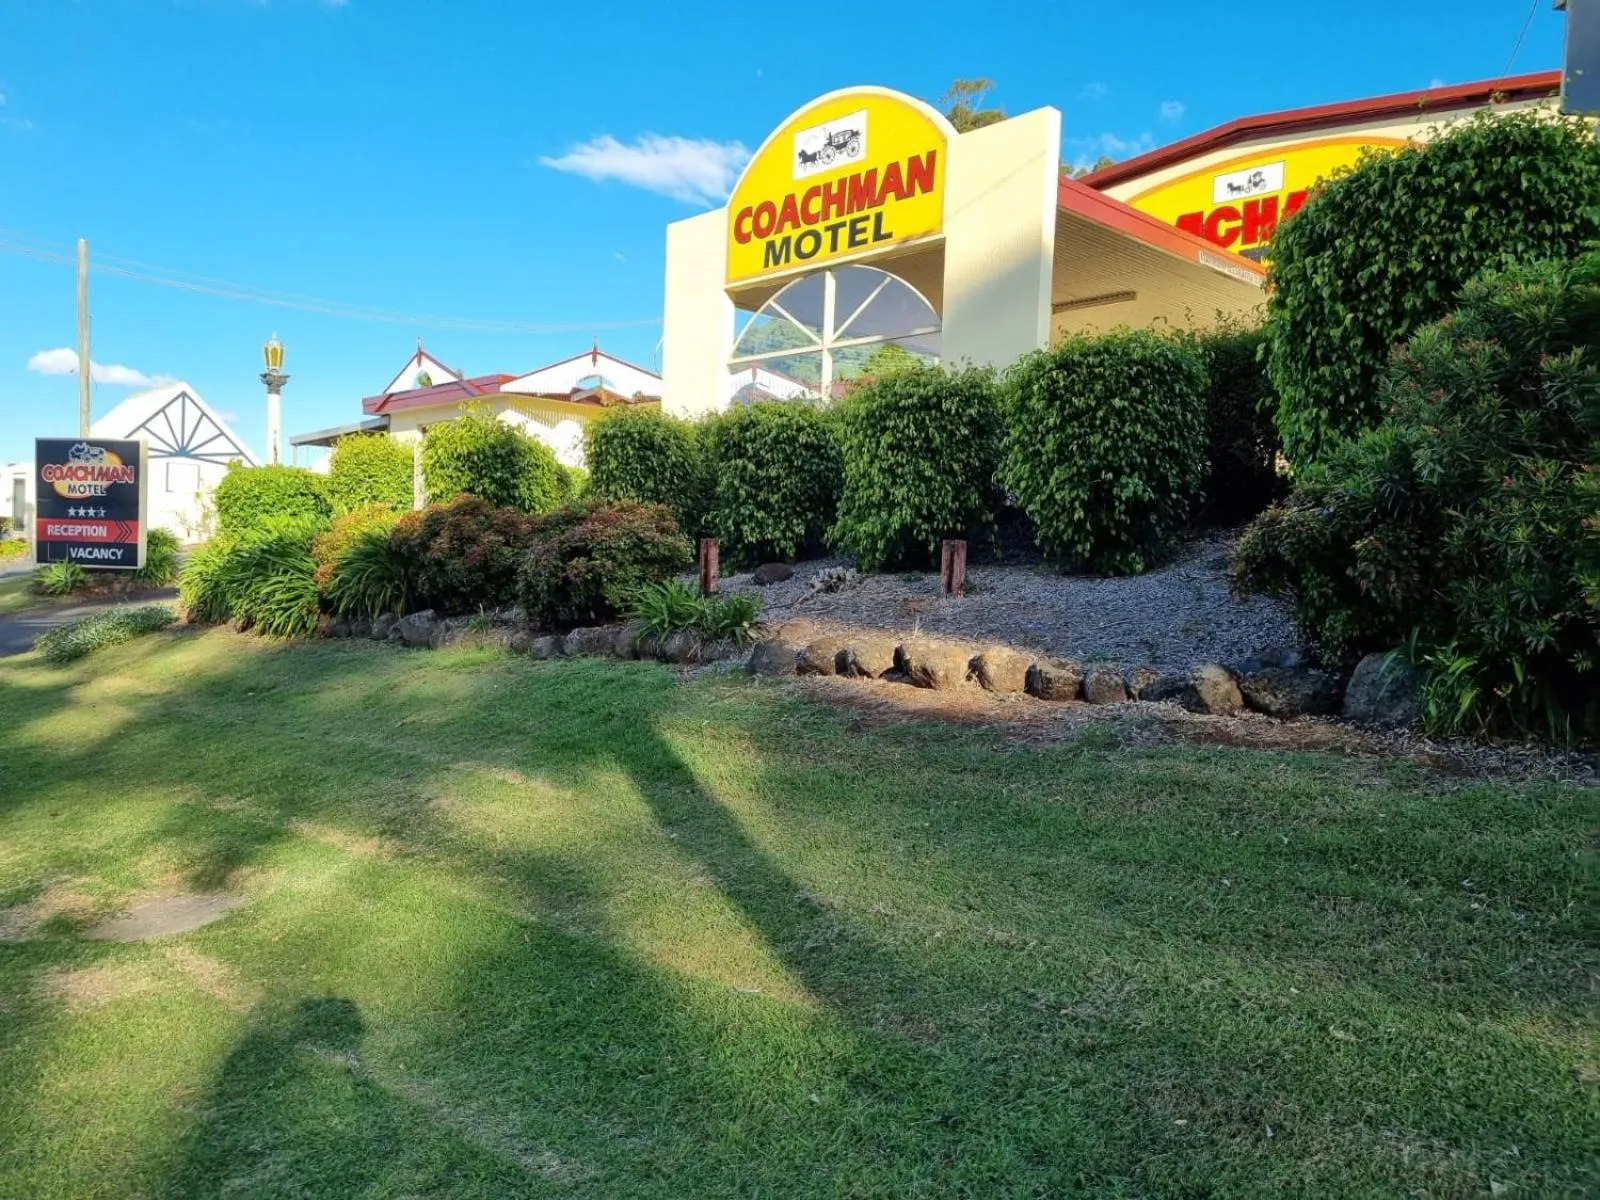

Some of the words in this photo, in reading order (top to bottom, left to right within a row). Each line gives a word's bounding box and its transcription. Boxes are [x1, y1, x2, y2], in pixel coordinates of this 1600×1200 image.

[734, 150, 937, 244] COACHMAN
[763, 211, 893, 269] MOTEL
[42, 464, 135, 484] COACHMAN
[67, 484, 107, 495] MOTEL
[47, 525, 107, 537] RECEPTION
[69, 547, 124, 560] VACANCY
